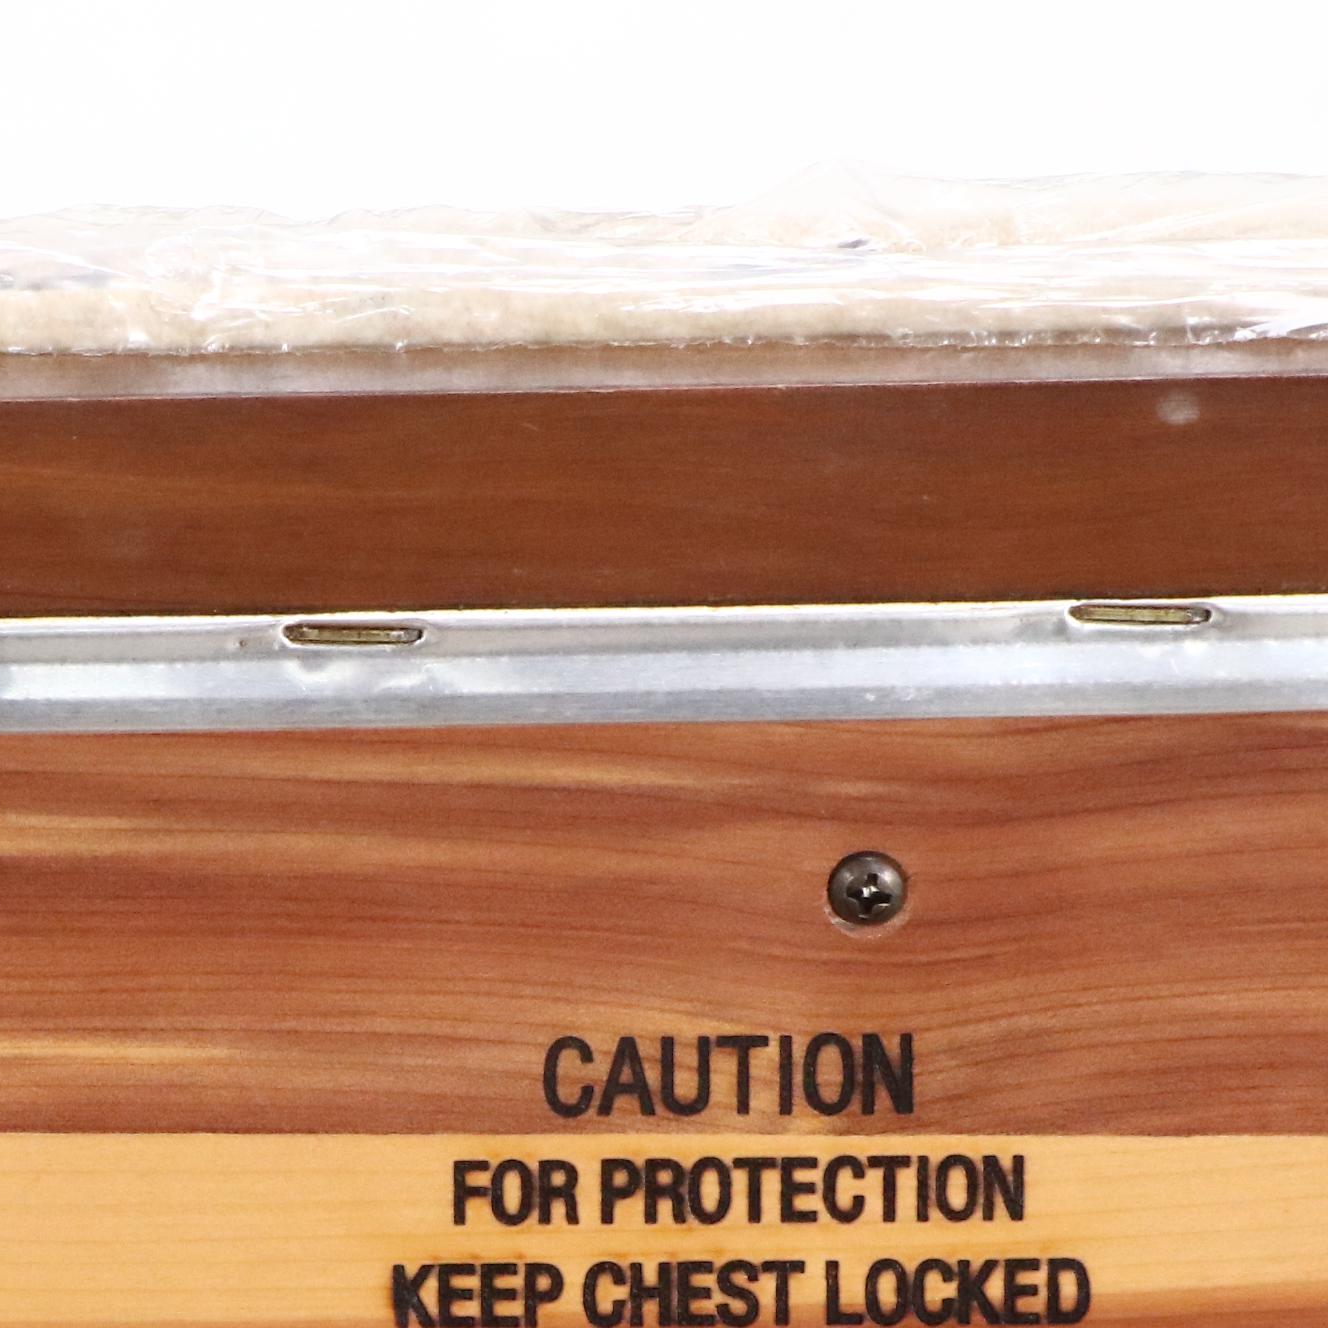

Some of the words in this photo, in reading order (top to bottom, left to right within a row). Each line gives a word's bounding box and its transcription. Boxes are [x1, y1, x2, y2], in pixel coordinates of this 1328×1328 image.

[542, 1031, 915, 1119] CAUTION
[452, 1158, 581, 1226] FOR
[599, 1153, 1026, 1225] PROTECTION
[825, 1257, 1093, 1328] LOCKED
